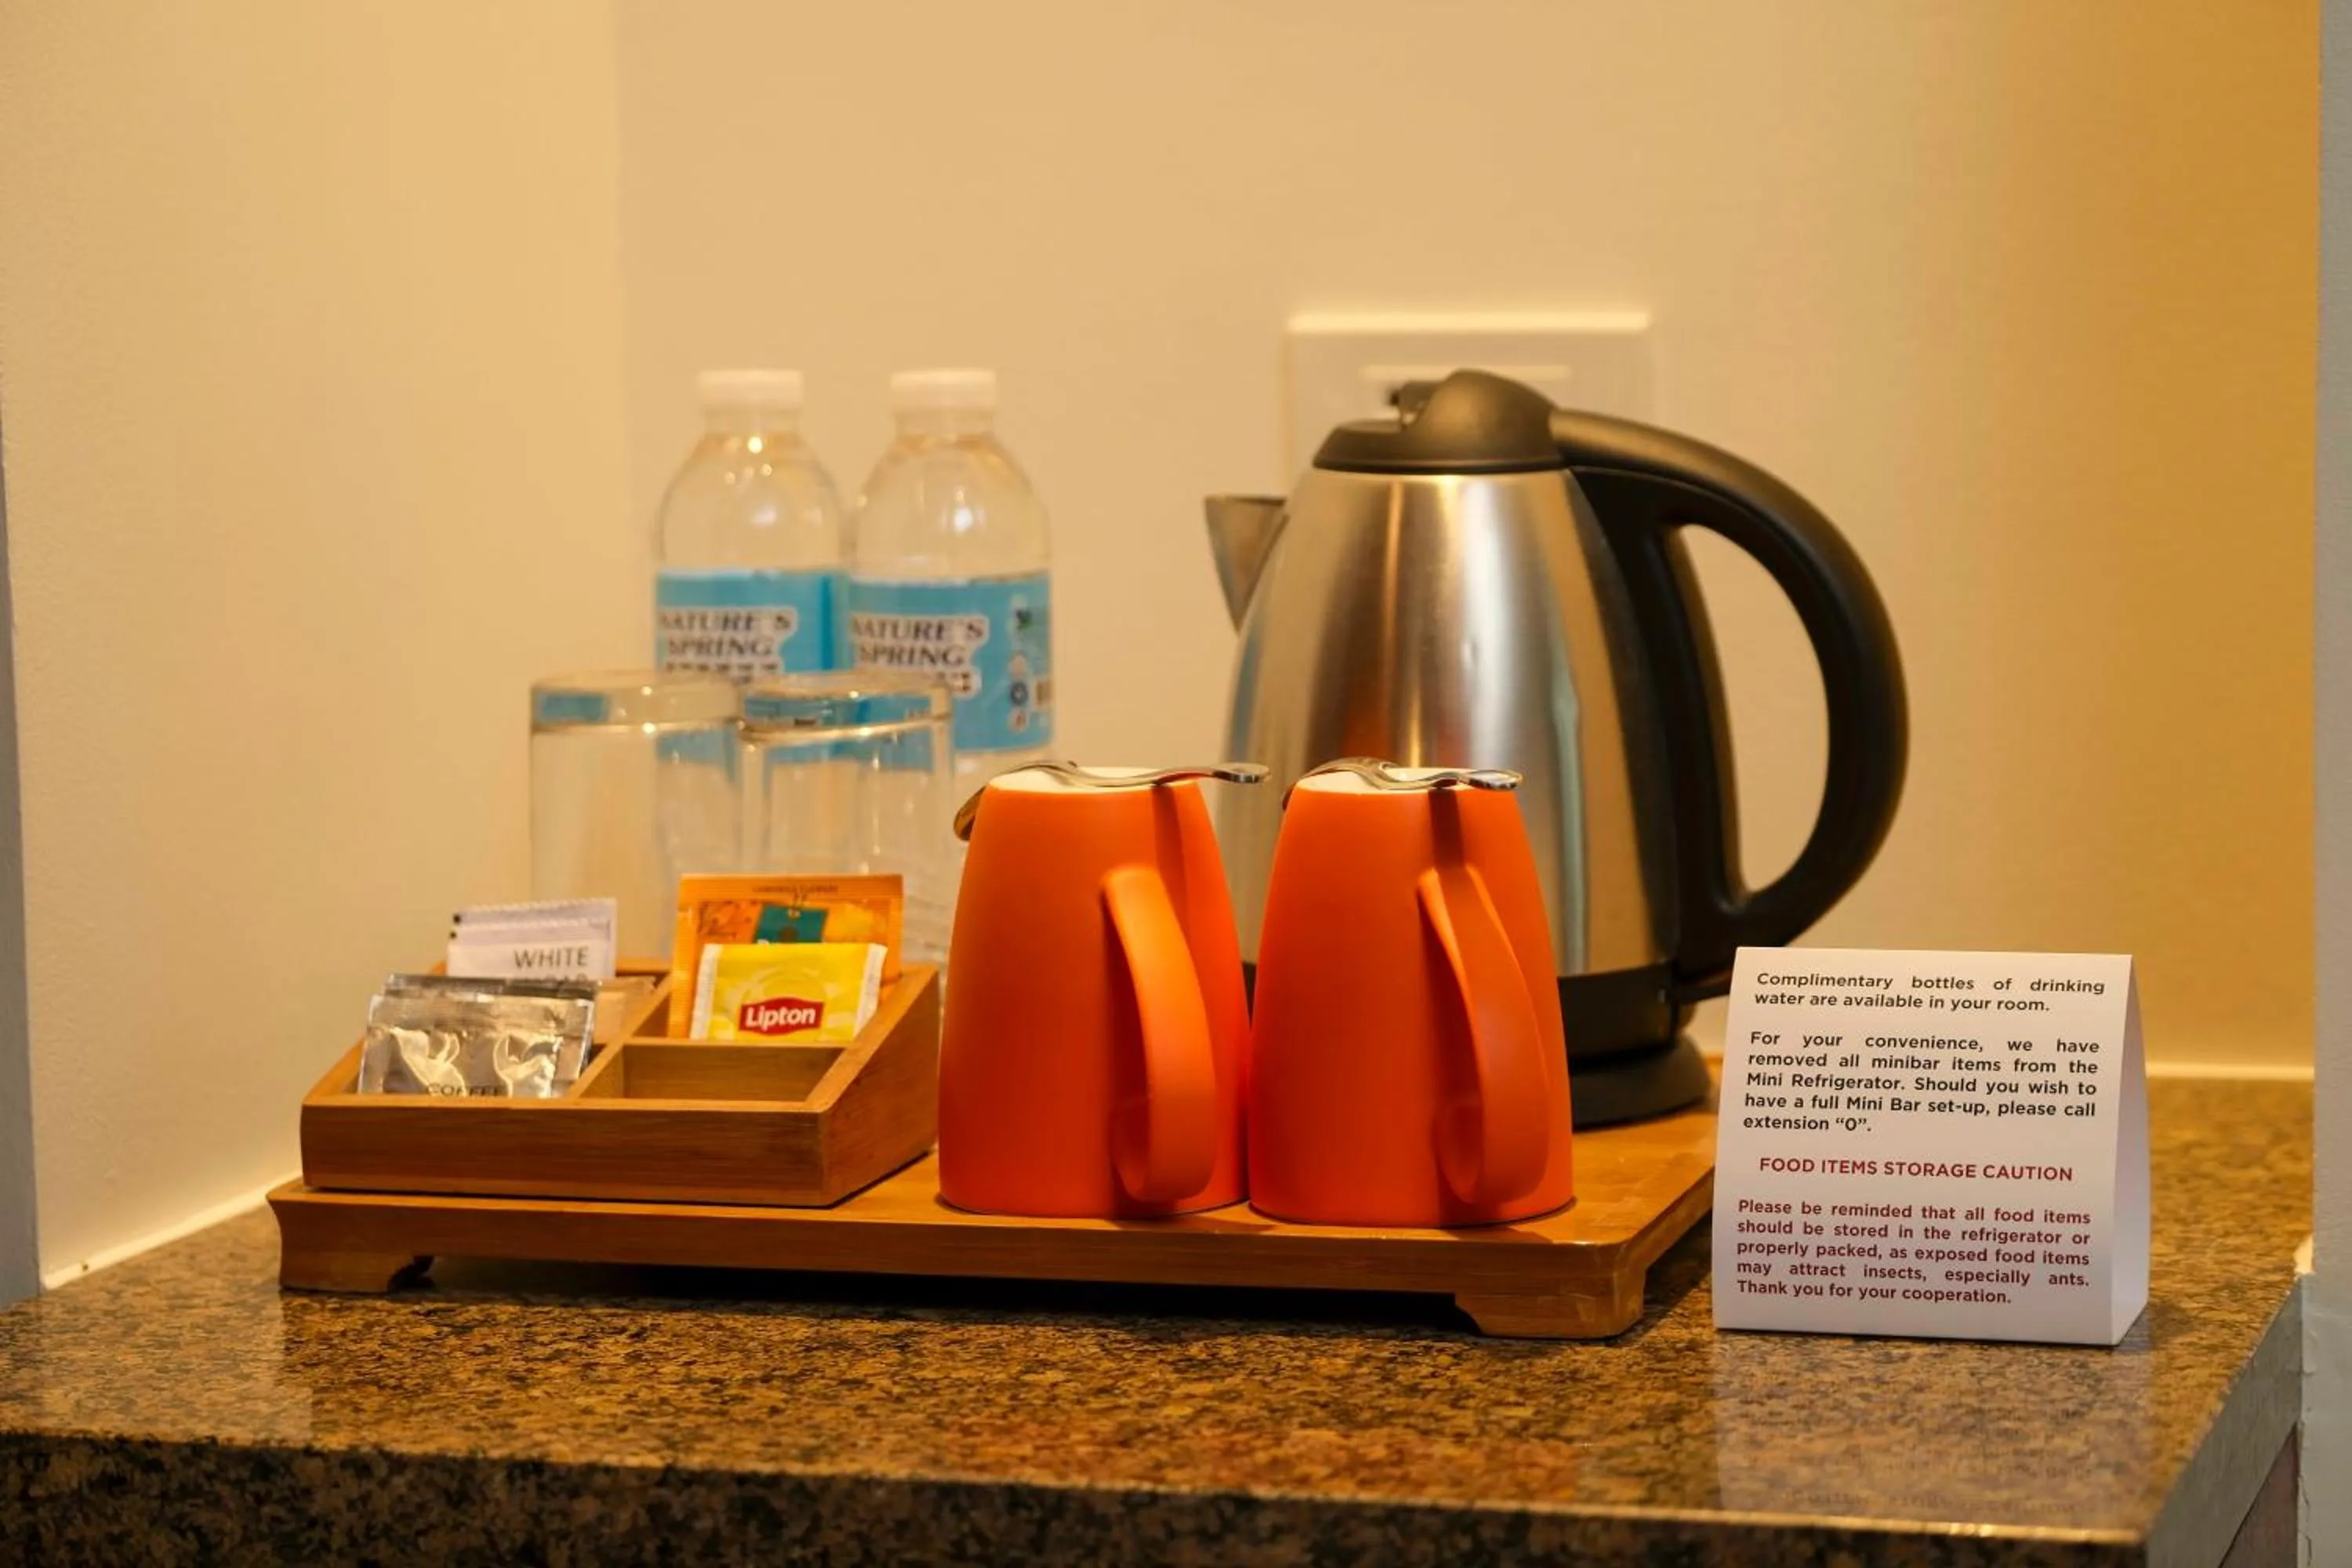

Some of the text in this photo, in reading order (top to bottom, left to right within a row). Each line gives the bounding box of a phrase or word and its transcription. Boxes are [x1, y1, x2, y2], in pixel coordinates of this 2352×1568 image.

[669, 637, 772, 659] SPRING
[860, 644, 966, 666] SPRING
[514, 946, 589, 968] WHITE
[1756, 971, 2106, 996] Complimentary bottles of drinking
[1754, 992, 2050, 1012] water are available in your room.
[746, 1005, 816, 1032] Lipton
[1750, 1030, 2100, 1054] For your convenience, we have
[1748, 1053, 2099, 1075] removed all minibar items from the
[1746, 1072, 2097, 1096] Mini Refrigerator. Should you wish to
[1744, 1092, 2096, 1117] have a full Mini Bar set-up, please call
[1743, 1115, 1830, 1131] extension
[1759, 1157, 2073, 1181] FOOD ITEMS STORAGE CAUTION
[1738, 1199, 2091, 1225] Please be reminded that all food items
[1737, 1219, 2091, 1245] should be stored in the refrigerator or
[1737, 1241, 2090, 1266] properly packed, as exposed food items
[1737, 1262, 2089, 1287] may attract insects, especially ants.
[1737, 1279, 2012, 1304] Thank you for your cooperation.
